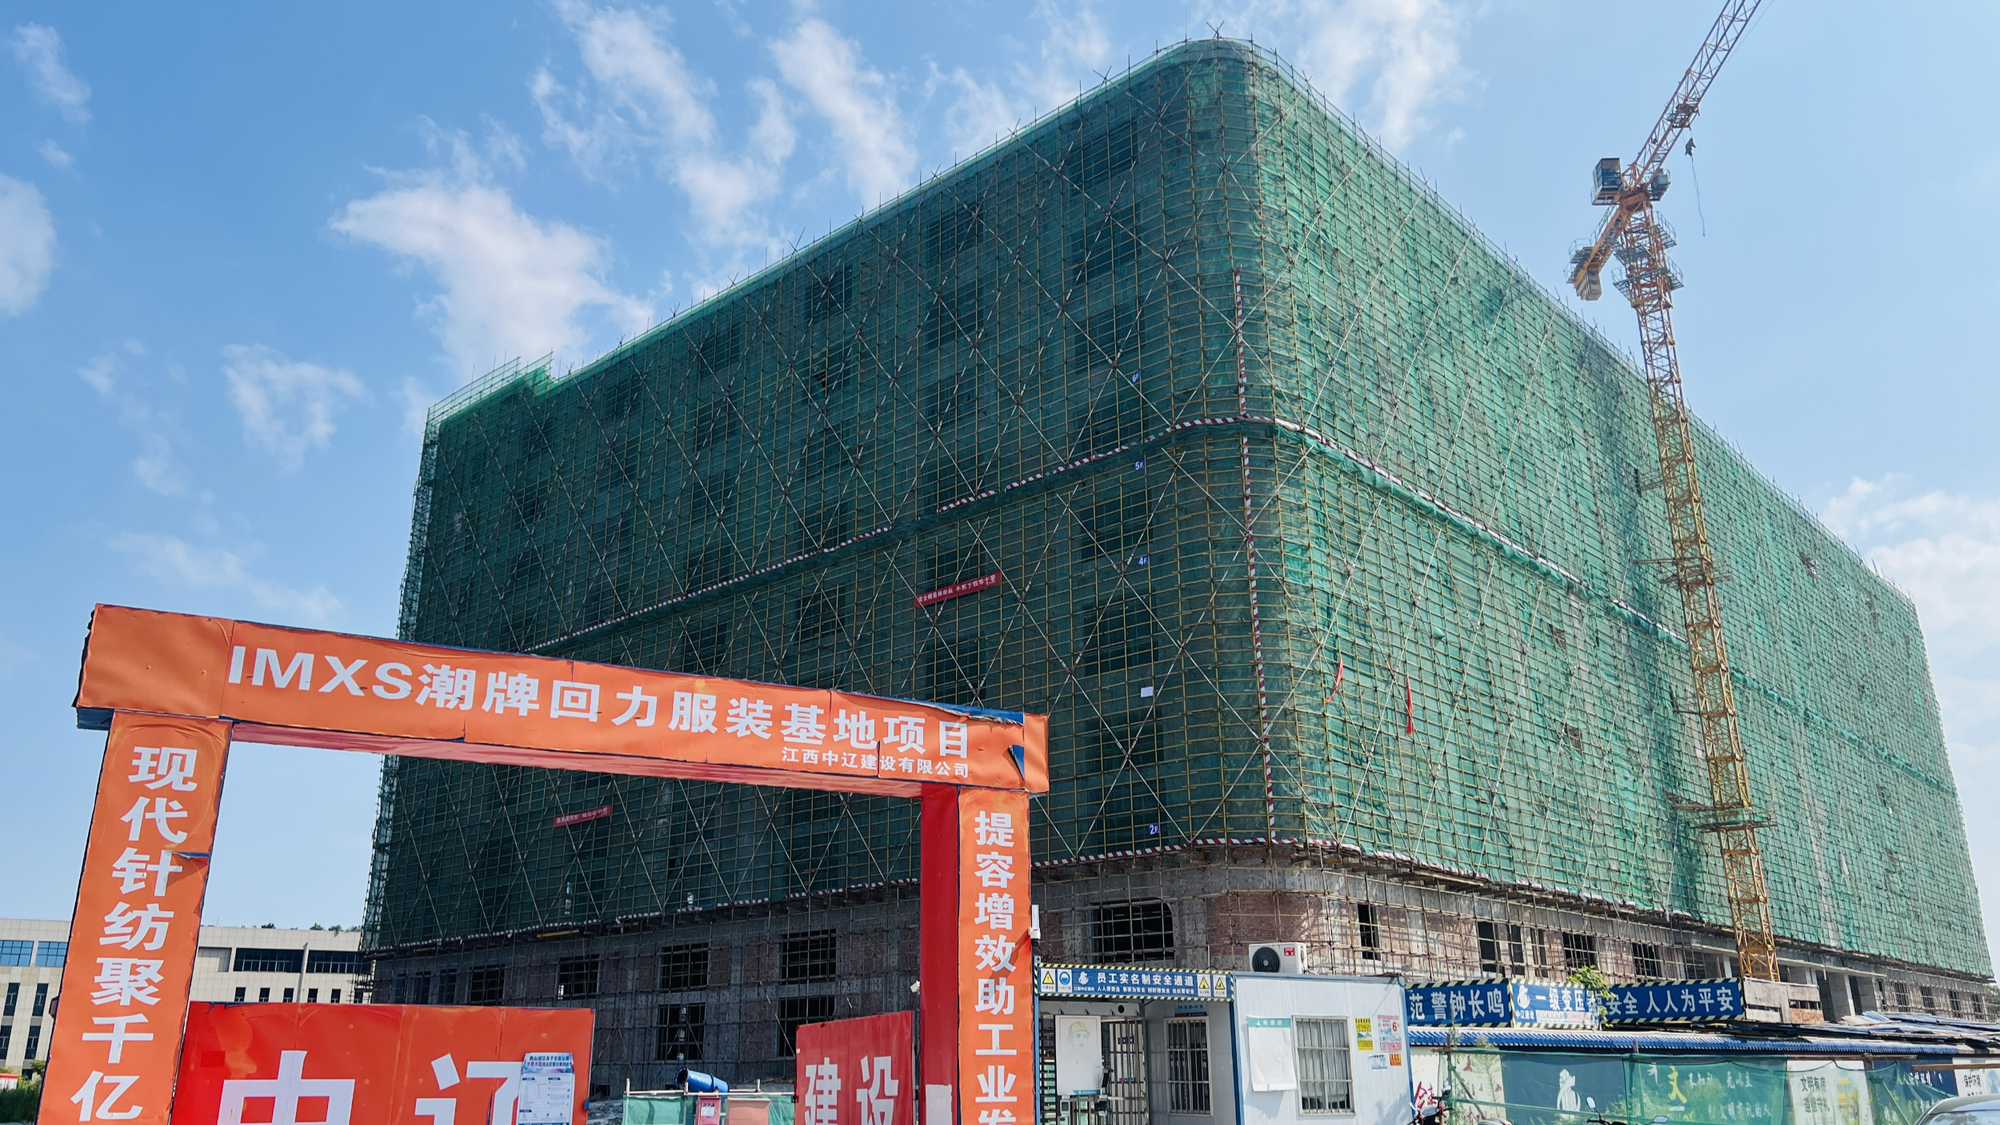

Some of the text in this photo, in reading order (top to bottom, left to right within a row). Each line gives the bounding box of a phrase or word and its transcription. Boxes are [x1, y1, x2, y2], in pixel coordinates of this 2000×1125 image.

[228, 645, 969, 759] IMXS潮牌回力服装基地项目
[781, 746, 970, 778] 江西中辽建设有限公司
[71, 746, 198, 1122] 现代针纺聚千亿
[1097, 972, 1194, 987] 员工实名制安全通道
[1409, 993, 1425, 1020] 范
[1431, 988, 1505, 1020] 警钟长鸣
[1646, 986, 1734, 1014] 人人为平安
